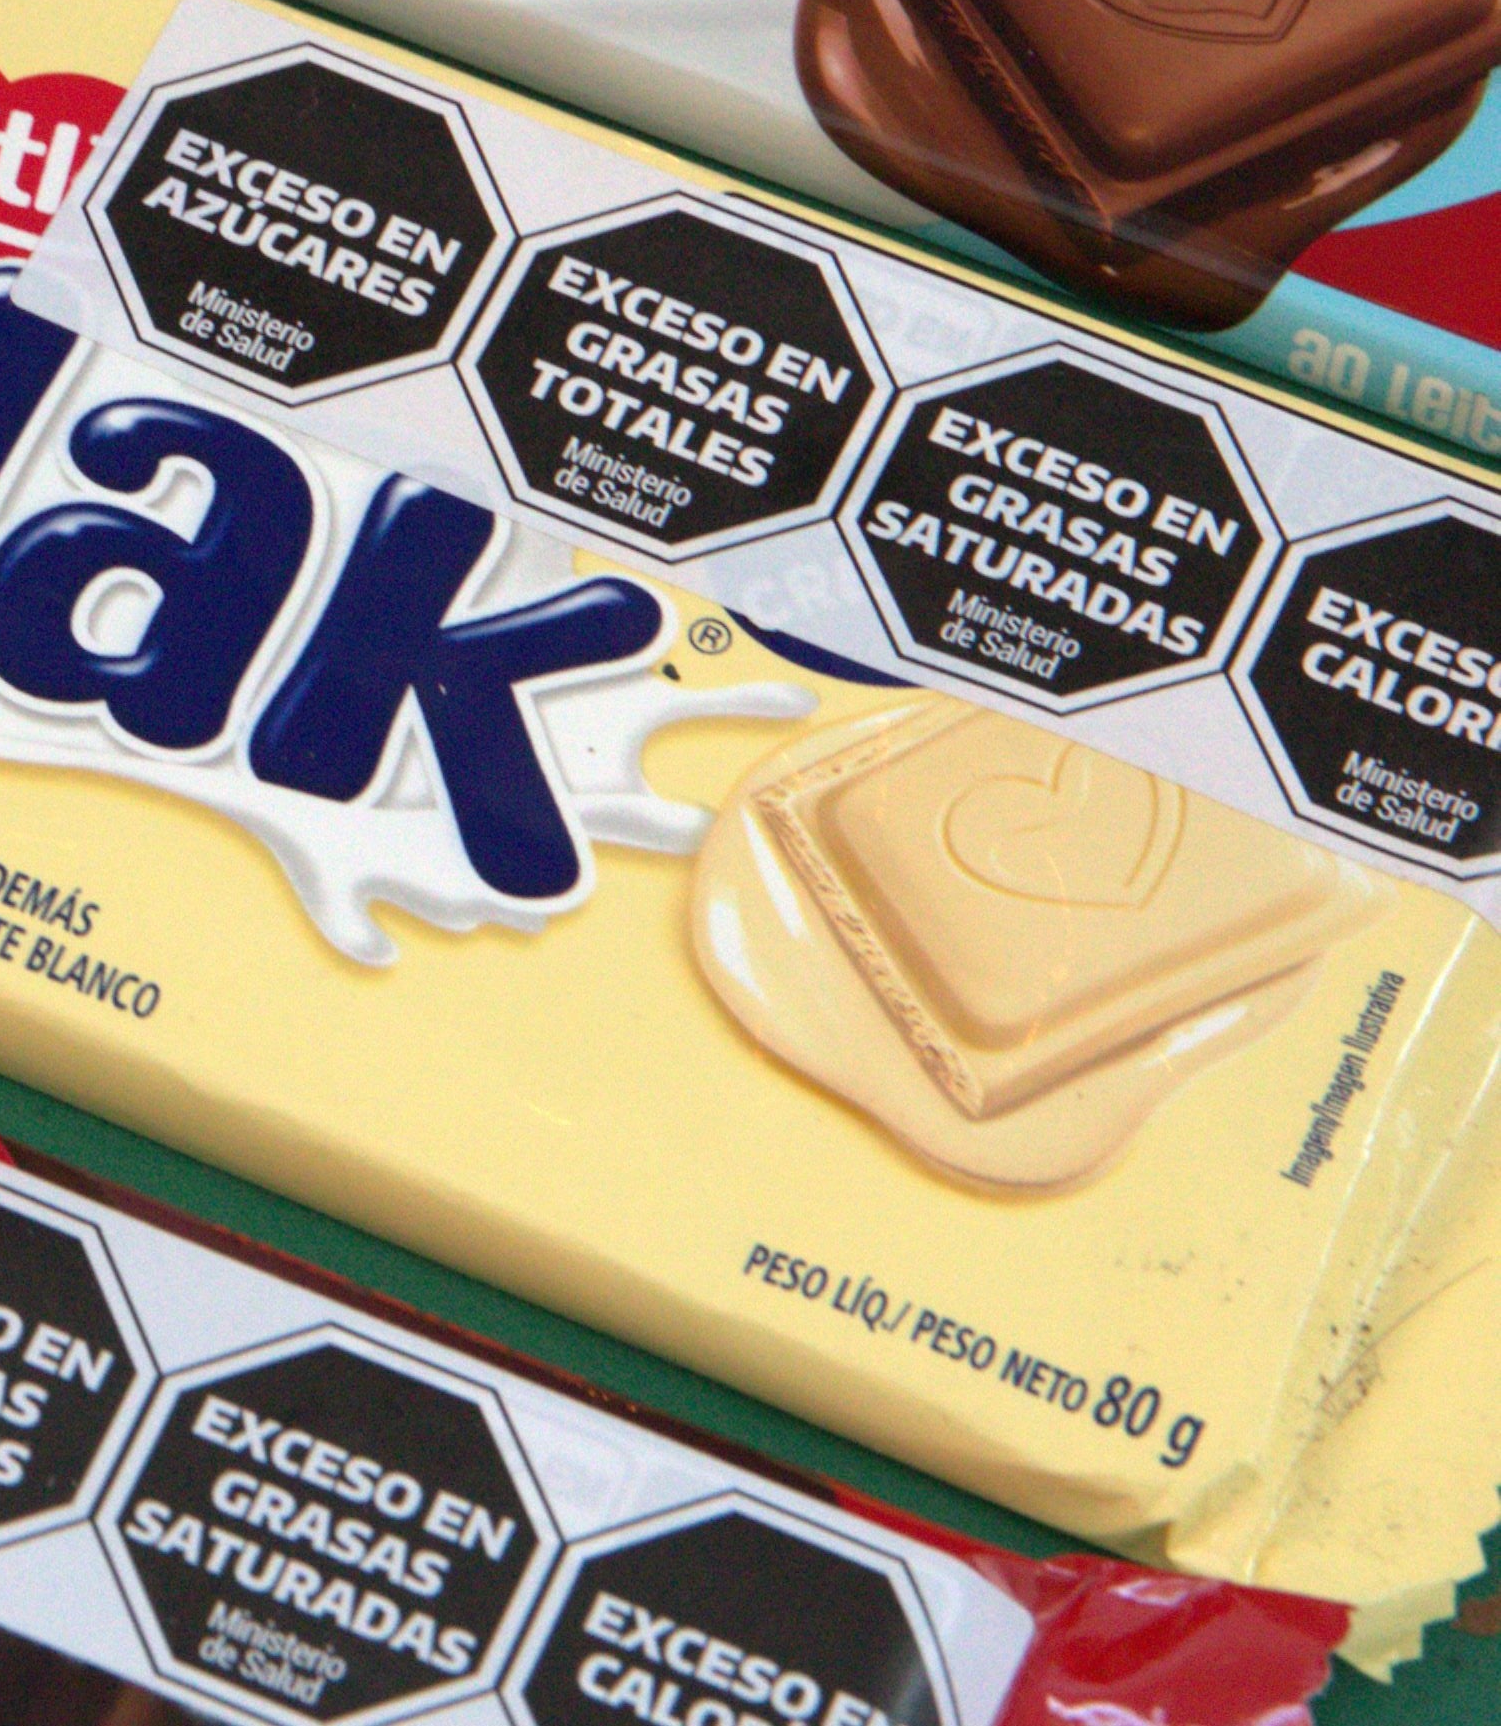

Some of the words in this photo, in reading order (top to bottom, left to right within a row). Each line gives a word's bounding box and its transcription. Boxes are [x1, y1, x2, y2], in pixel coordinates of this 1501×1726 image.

[143, 176, 435, 316] AZÚCARES
[165, 129, 376, 238] EXCESO
[376, 215, 461, 274] EN
[179, 310, 215, 339] de
[216, 322, 295, 372] Salud
[188, 280, 315, 351] Ministerio
[549, 256, 764, 366] EXCESO
[766, 343, 851, 403] EN
[531, 359, 774, 486] TOTALES
[566, 322, 789, 434] GRASAS
[554, 464, 590, 495] de
[591, 478, 672, 528] Salud
[562, 436, 692, 507] Ministerio
[929, 407, 1150, 518] EXCESO
[1152, 495, 1239, 556] EN
[866, 501, 1204, 655] SATURADAS
[949, 474, 1177, 586] GRASAS
[939, 617, 976, 648] de
[979, 630, 1061, 679] Salud
[947, 588, 1081, 659] Ministerio
[1336, 780, 1374, 812] de
[1376, 794, 1460, 842] Salud
[1343, 750, 1480, 821] Ministerio
[25, 935, 161, 1019] BLANCO
[24, 1324, 113, 1391] EN
[743, 1243, 829, 1300] PESO
[911, 1309, 997, 1371] PESO
[1000, 1349, 1089, 1413] NETO
[1092, 1375, 1162, 1438] 80
[1160, 1414, 1205, 1469] g
[193, 1396, 422, 1518] EXCESO
[424, 1492, 515, 1559] EN
[212, 1471, 449, 1596] GRASAS
[123, 1501, 476, 1675] SATURADAS
[207, 1601, 347, 1681] Ministerio
[199, 1634, 238, 1669] de
[239, 1648, 325, 1705] Salud
[584, 1593, 820, 1726] EXCESO
